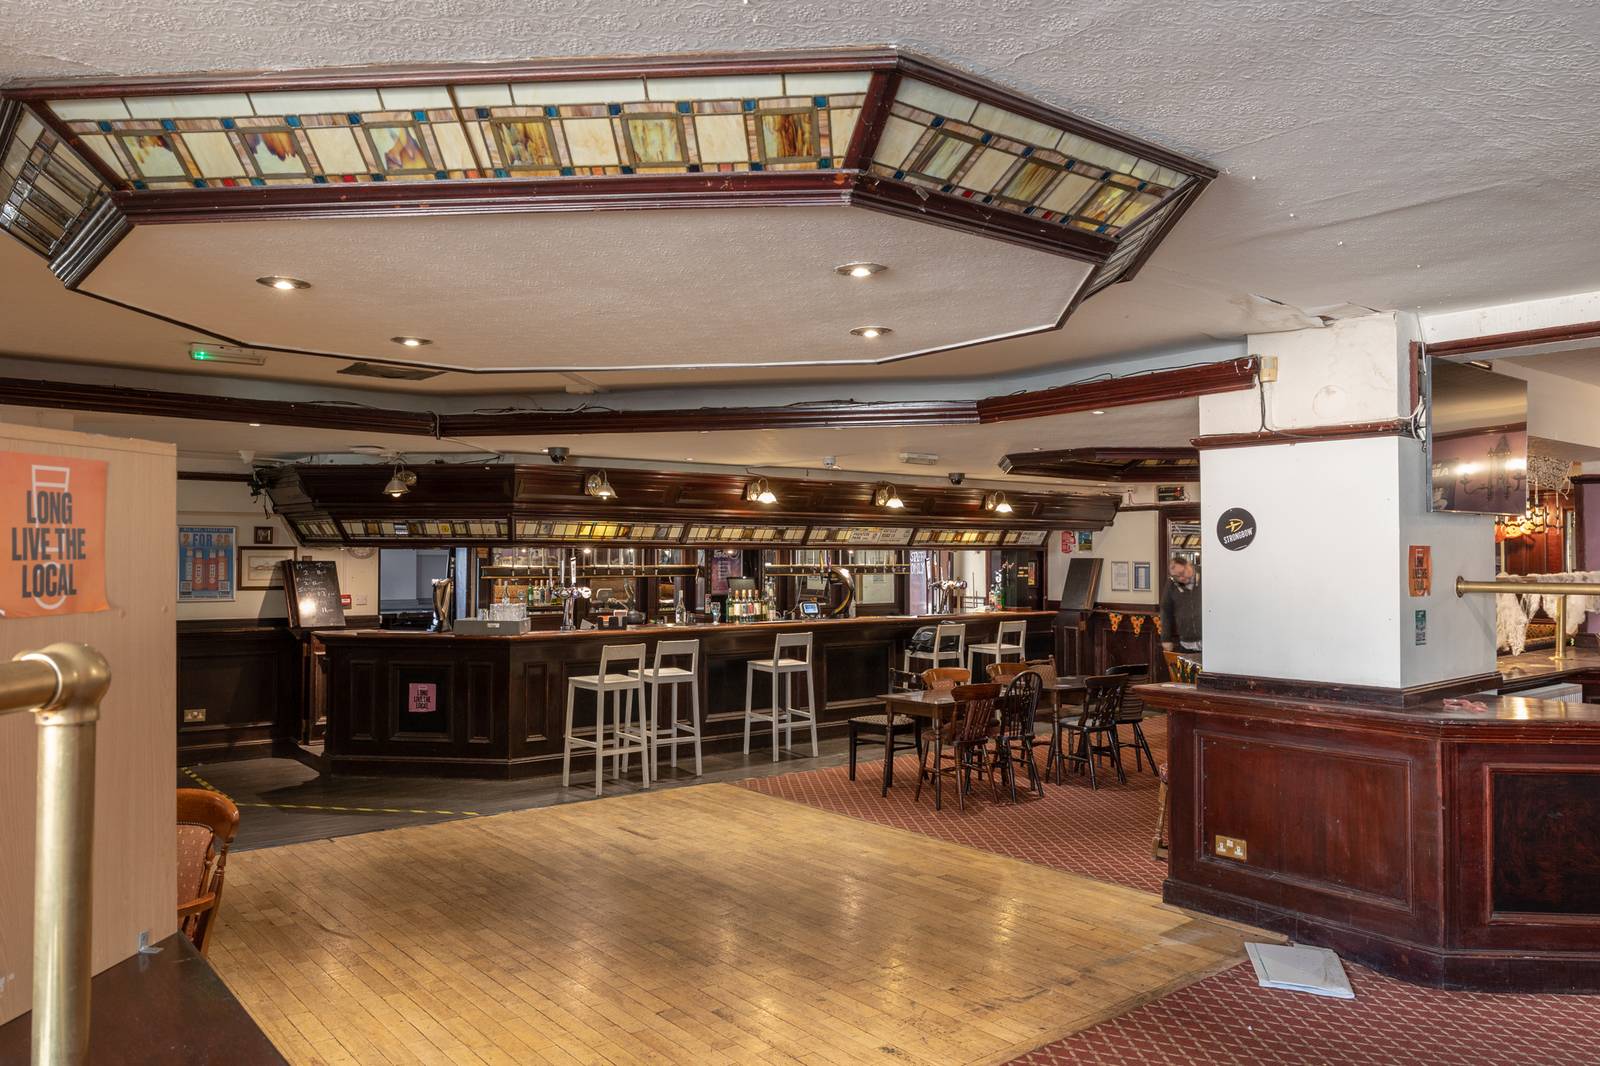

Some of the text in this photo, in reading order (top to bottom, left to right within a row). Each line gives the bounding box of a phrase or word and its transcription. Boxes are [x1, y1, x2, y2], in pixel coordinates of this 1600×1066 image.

[26, 490, 73, 524] LONG
[11, 527, 86, 561] LIVE THE
[1223, 527, 1253, 544] STRONGBOW
[22, 563, 77, 598] LOCAL
